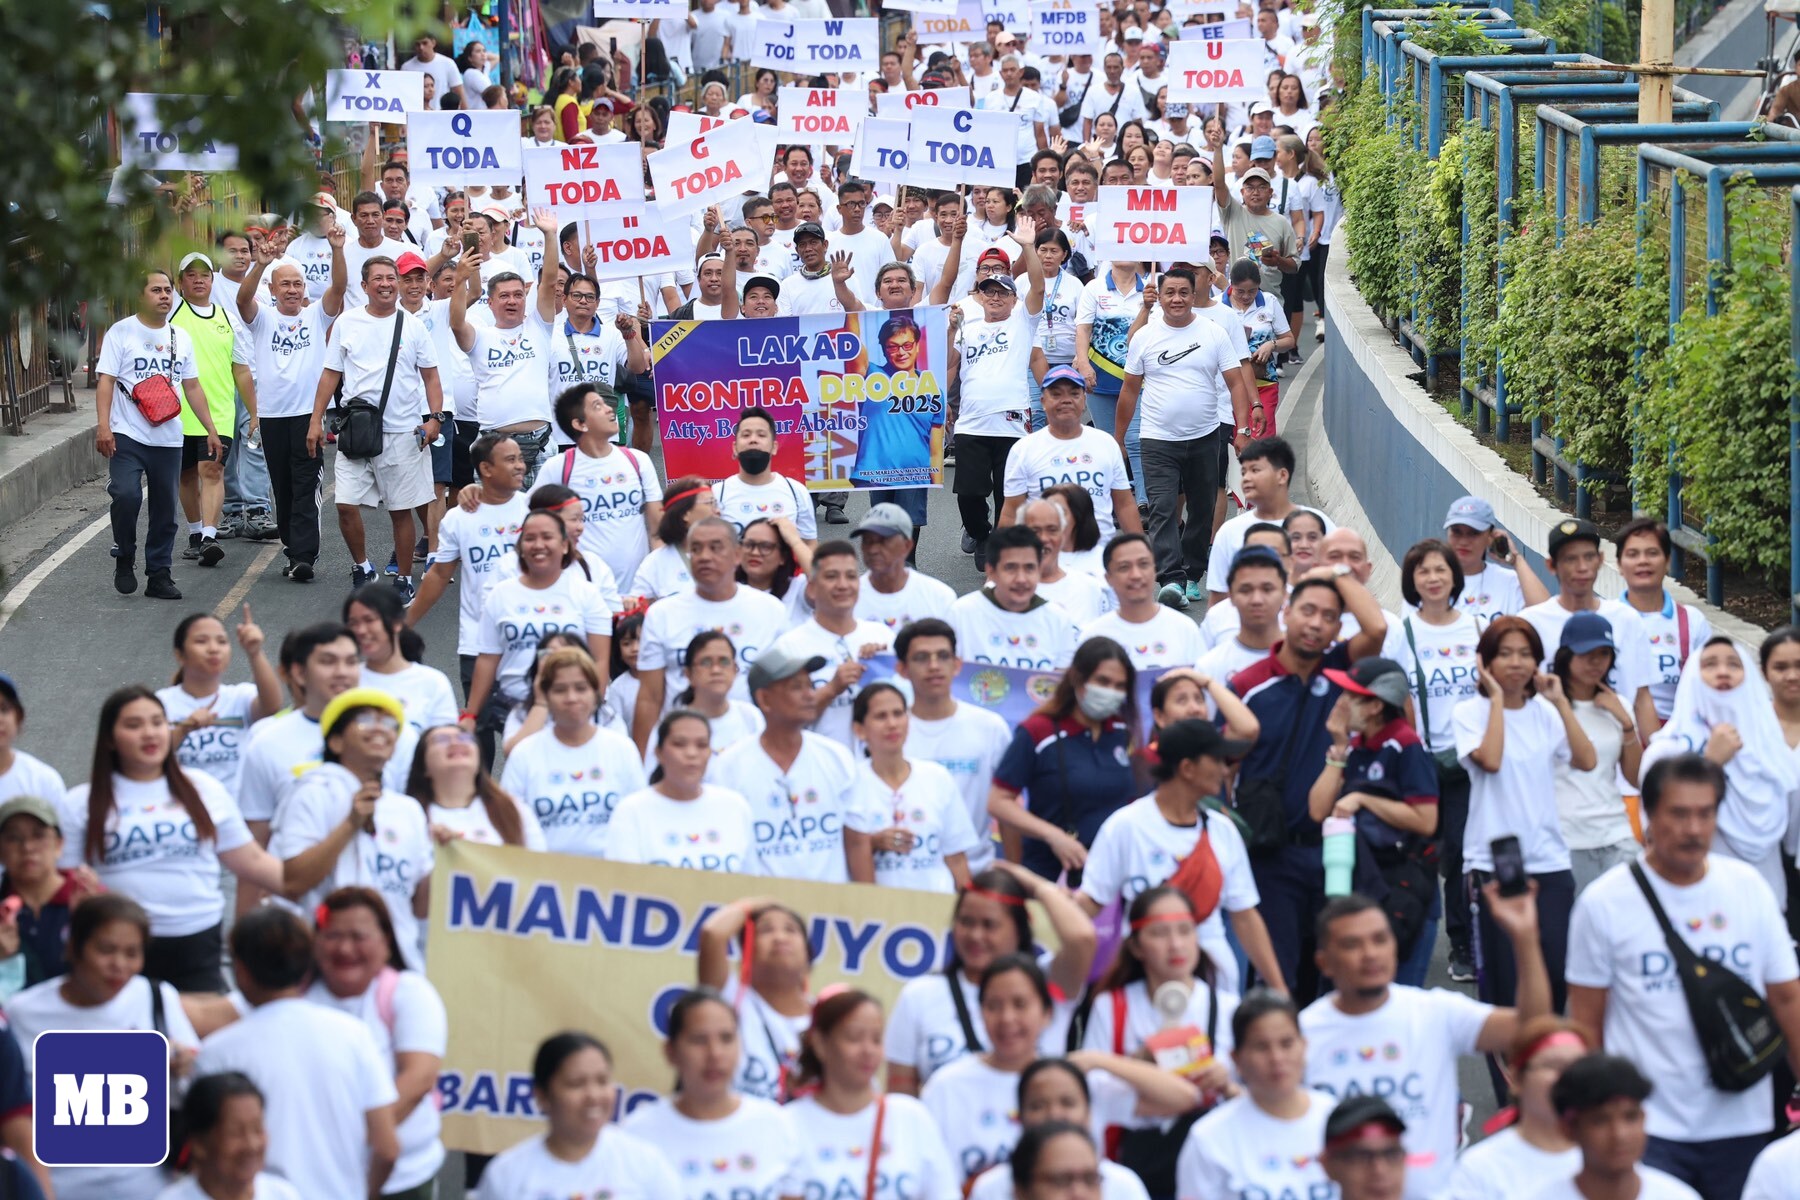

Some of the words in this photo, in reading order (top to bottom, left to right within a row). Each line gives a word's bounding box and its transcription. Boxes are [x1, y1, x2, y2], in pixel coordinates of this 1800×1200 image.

[824, 20, 844, 36] W
[923, 18, 971, 33] TODA
[983, 12, 1016, 24] ODA
[1041, 11, 1087, 25] MFDB
[1042, 31, 1086, 45] TODA
[1202, 26, 1224, 40] EE
[765, 43, 795, 60] TOD
[807, 44, 862, 60] TODA
[1207, 41, 1223, 60] U
[365, 72, 381, 89] X
[1183, 68, 1244, 89] TODA
[341, 95, 403, 112] TODA
[806, 90, 836, 107] AH
[451, 113, 472, 137] Q
[791, 115, 850, 132] TODA
[952, 110, 973, 133] C
[425, 146, 500, 169] TODA
[560, 146, 599, 171] NZ
[690, 136, 710, 160] G
[925, 140, 996, 169] TODA
[671, 159, 742, 200] TODA
[544, 178, 621, 206] TODA
[1126, 188, 1178, 211] MM
[1113, 222, 1187, 245] TODA
[596, 234, 671, 263] TODA
[656, 324, 687, 352] TODA
[966, 331, 1008, 360] DAC
[488, 338, 533, 361] DAC
[514, 350, 536, 361] 2025
[737, 332, 862, 367] LAKAD
[557, 360, 610, 376] DAPC
[589, 374, 609, 384] 2025
[662, 375, 810, 413] KONTRA
[819, 369, 943, 404] DROGA
[887, 394, 943, 414] 2025
[665, 418, 712, 446] Atty.
[795, 411, 868, 436] Abalos
[179, 730, 240, 750] APC
[753, 812, 840, 845] DAPC
